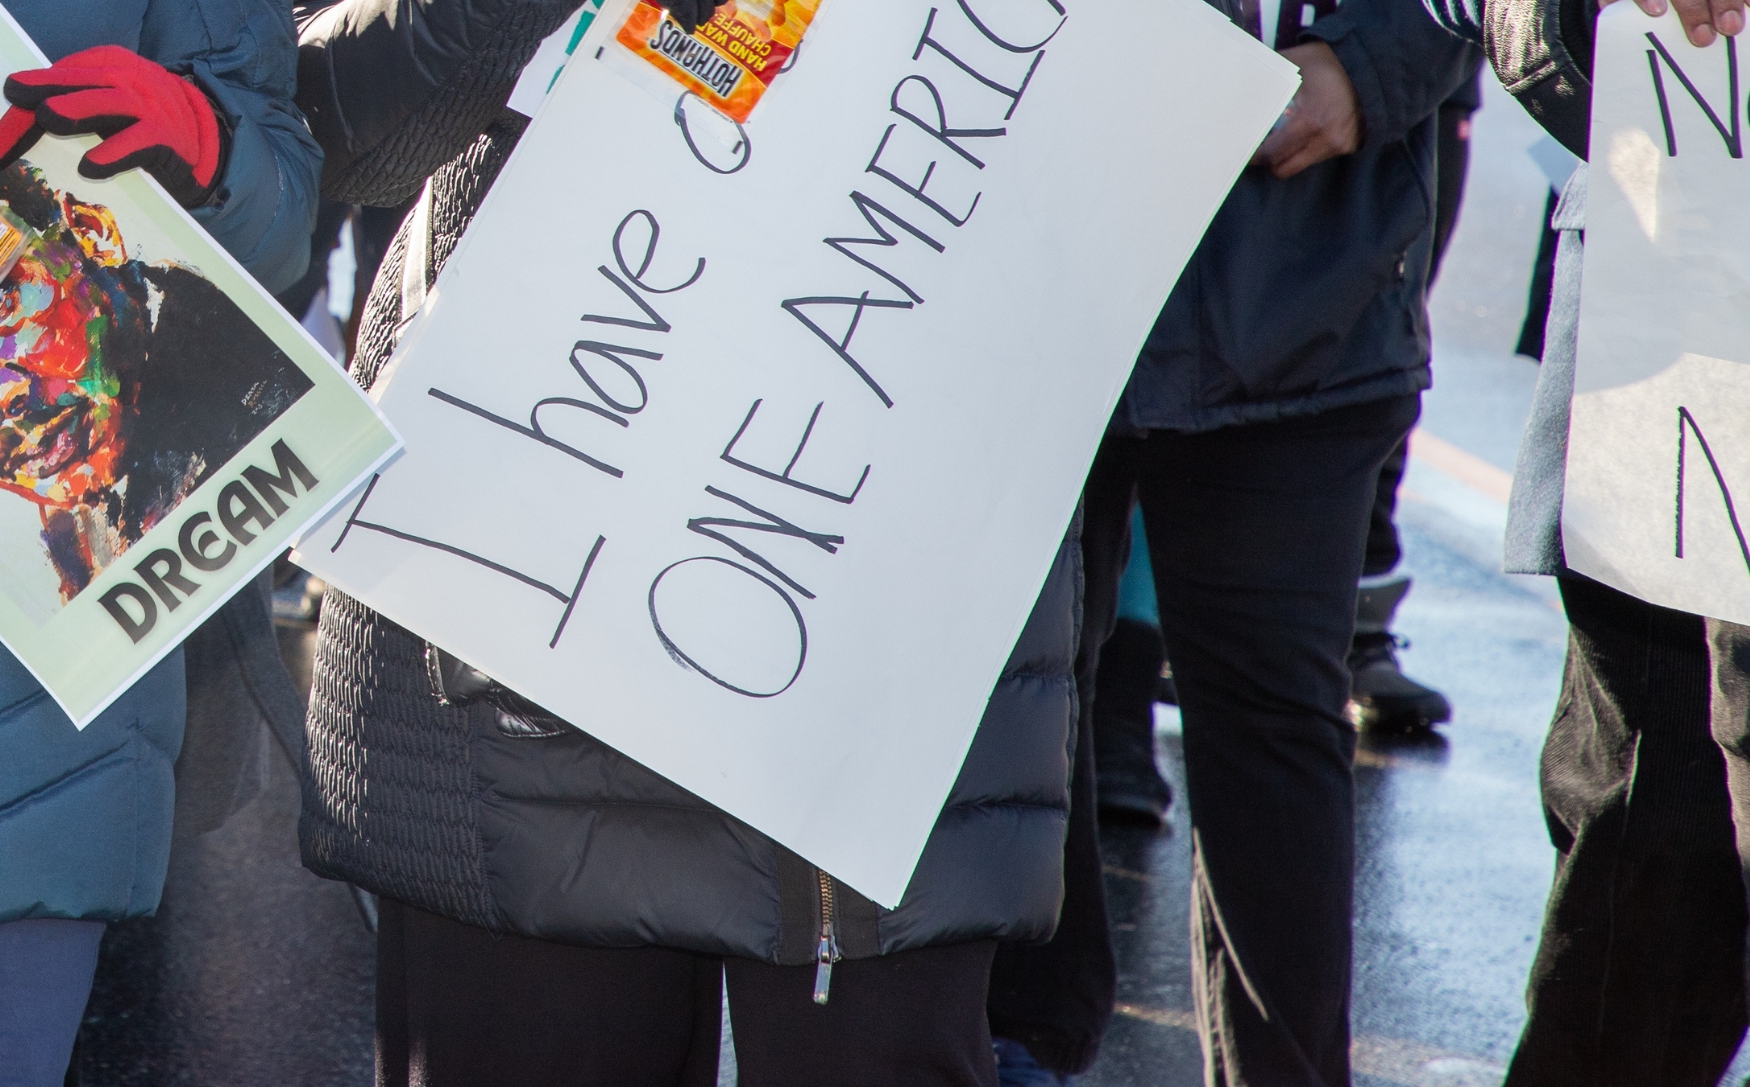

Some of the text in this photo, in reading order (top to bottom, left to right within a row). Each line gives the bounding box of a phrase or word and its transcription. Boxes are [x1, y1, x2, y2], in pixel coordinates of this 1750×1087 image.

[650, 19, 744, 98] HOTHANDS
[713, 13, 772, 57] CHAUFFE-
[728, 40, 768, 72] HAND
[428, 208, 706, 479] have
[97, 437, 320, 645] DREAM
[331, 474, 605, 648] I
[646, 397, 872, 699] ONE
